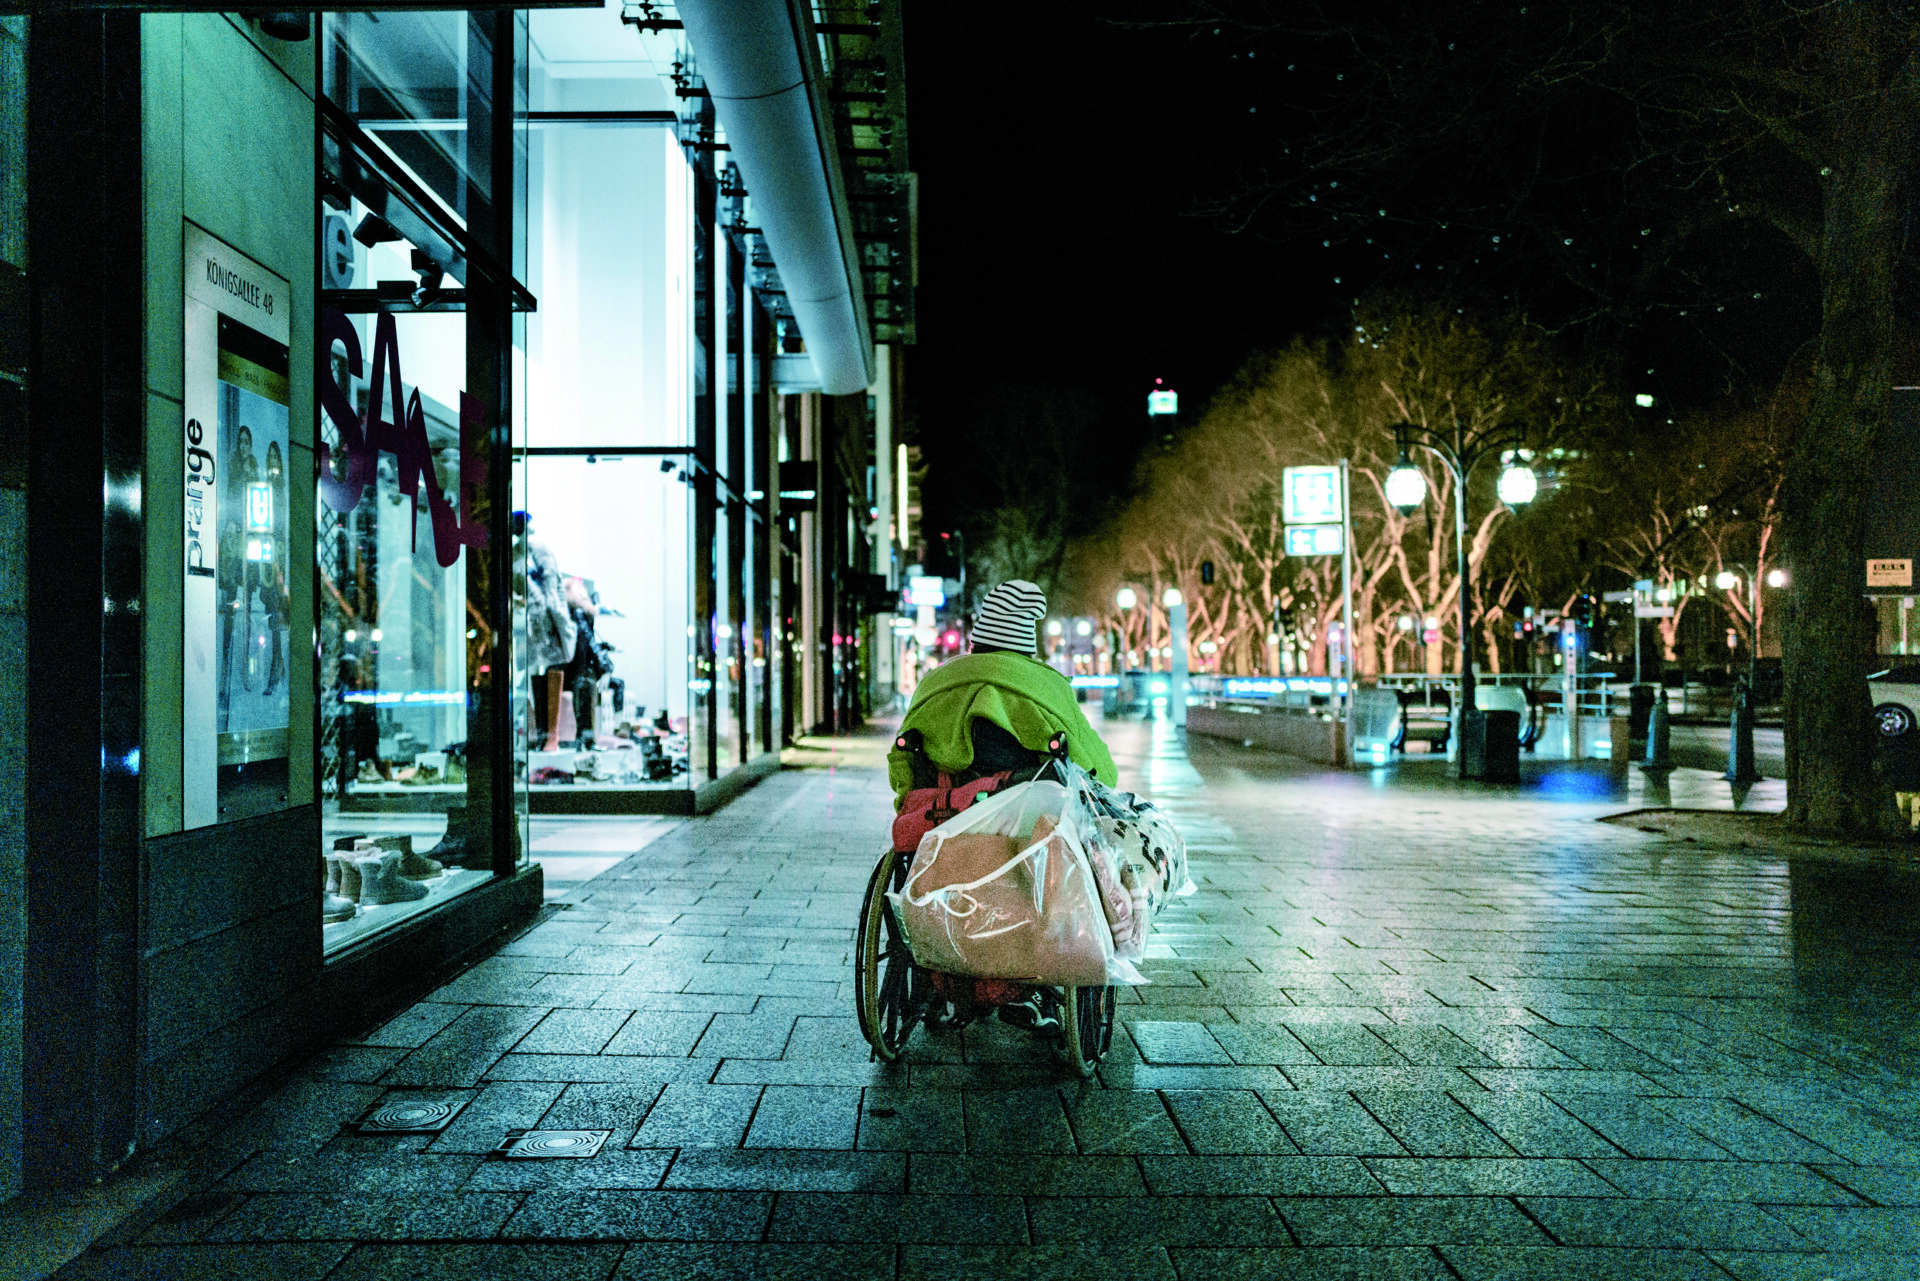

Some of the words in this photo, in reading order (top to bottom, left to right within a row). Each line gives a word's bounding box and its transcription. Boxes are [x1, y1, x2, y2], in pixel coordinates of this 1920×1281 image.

[206, 257, 260, 309] KÖNIGSALLEE
[262, 292, 274, 316] 48
[186, 418, 216, 579] prange
[320, 309, 488, 568] SALE
